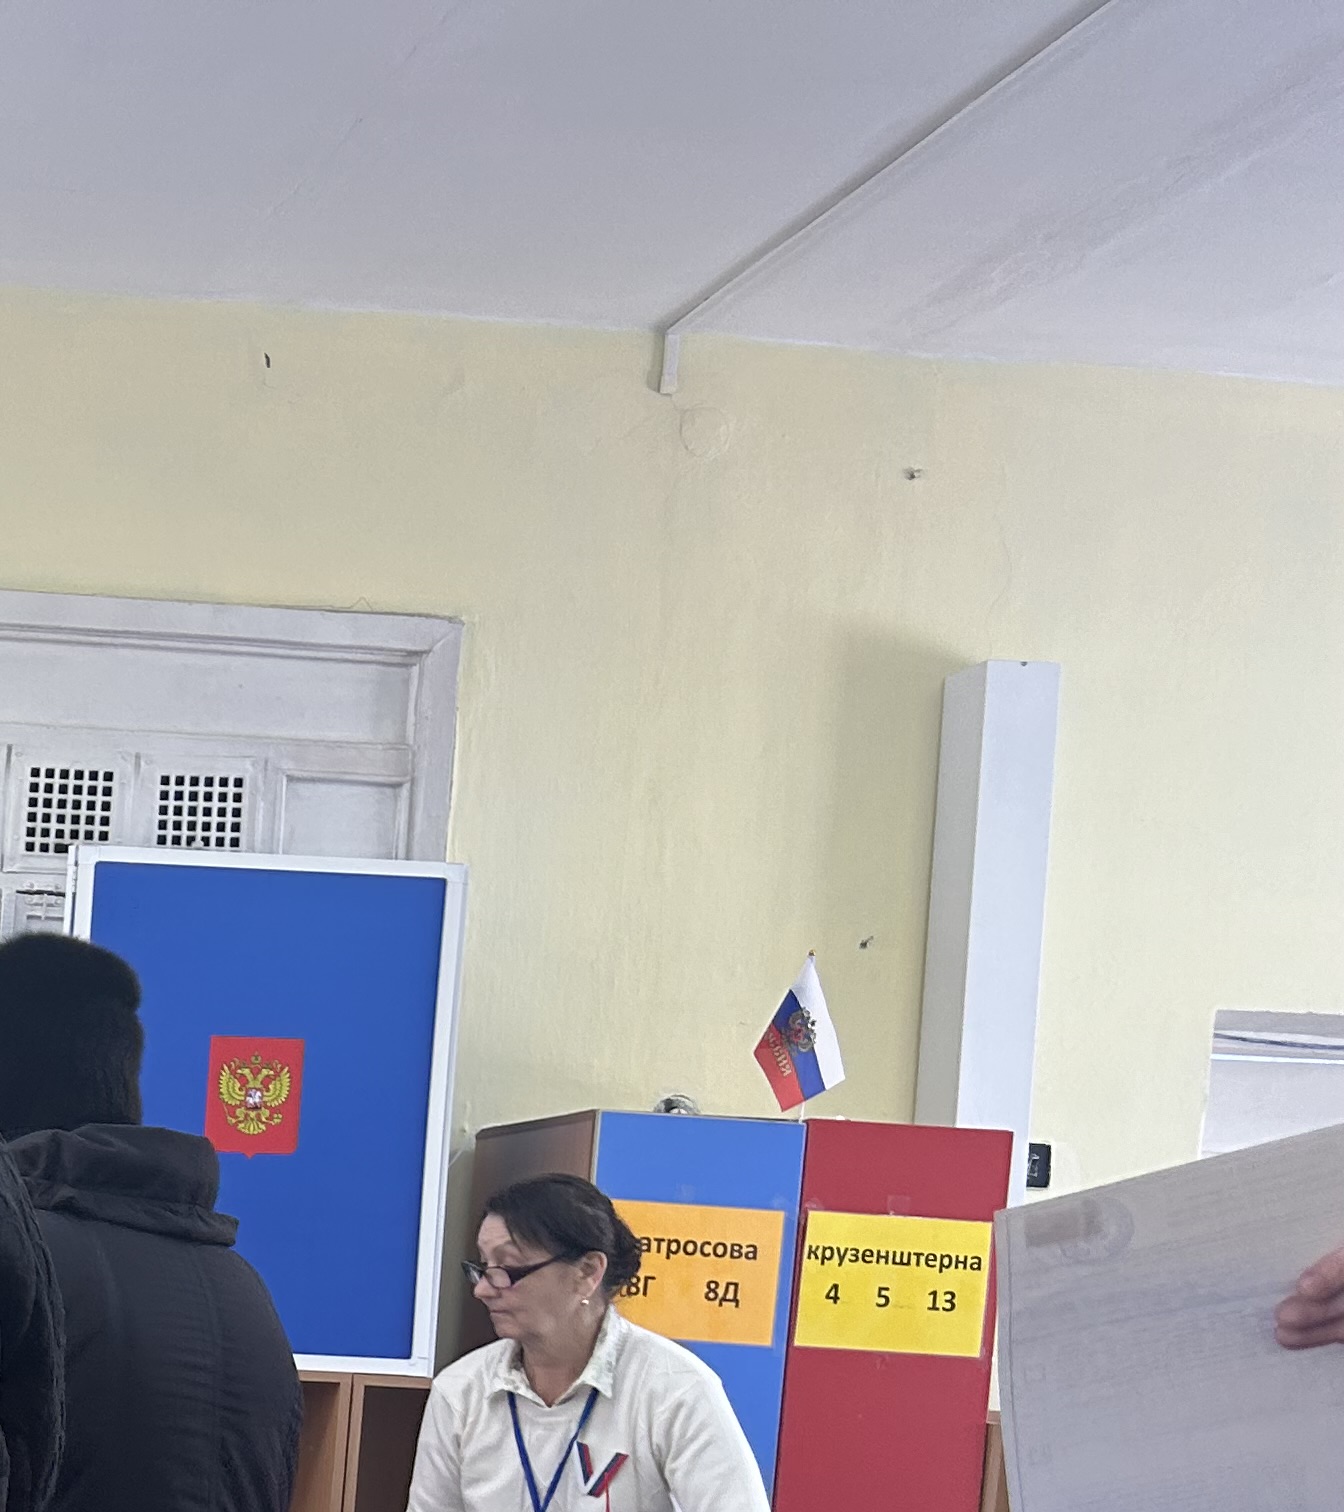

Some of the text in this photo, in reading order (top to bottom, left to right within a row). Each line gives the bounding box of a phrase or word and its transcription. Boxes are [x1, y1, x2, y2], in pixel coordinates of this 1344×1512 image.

[640, 1236, 758, 1260] атросова
[806, 1244, 983, 1274] крузенштерна
[704, 1280, 741, 1308] 8Д
[825, 1283, 957, 1312] 4 5 13
